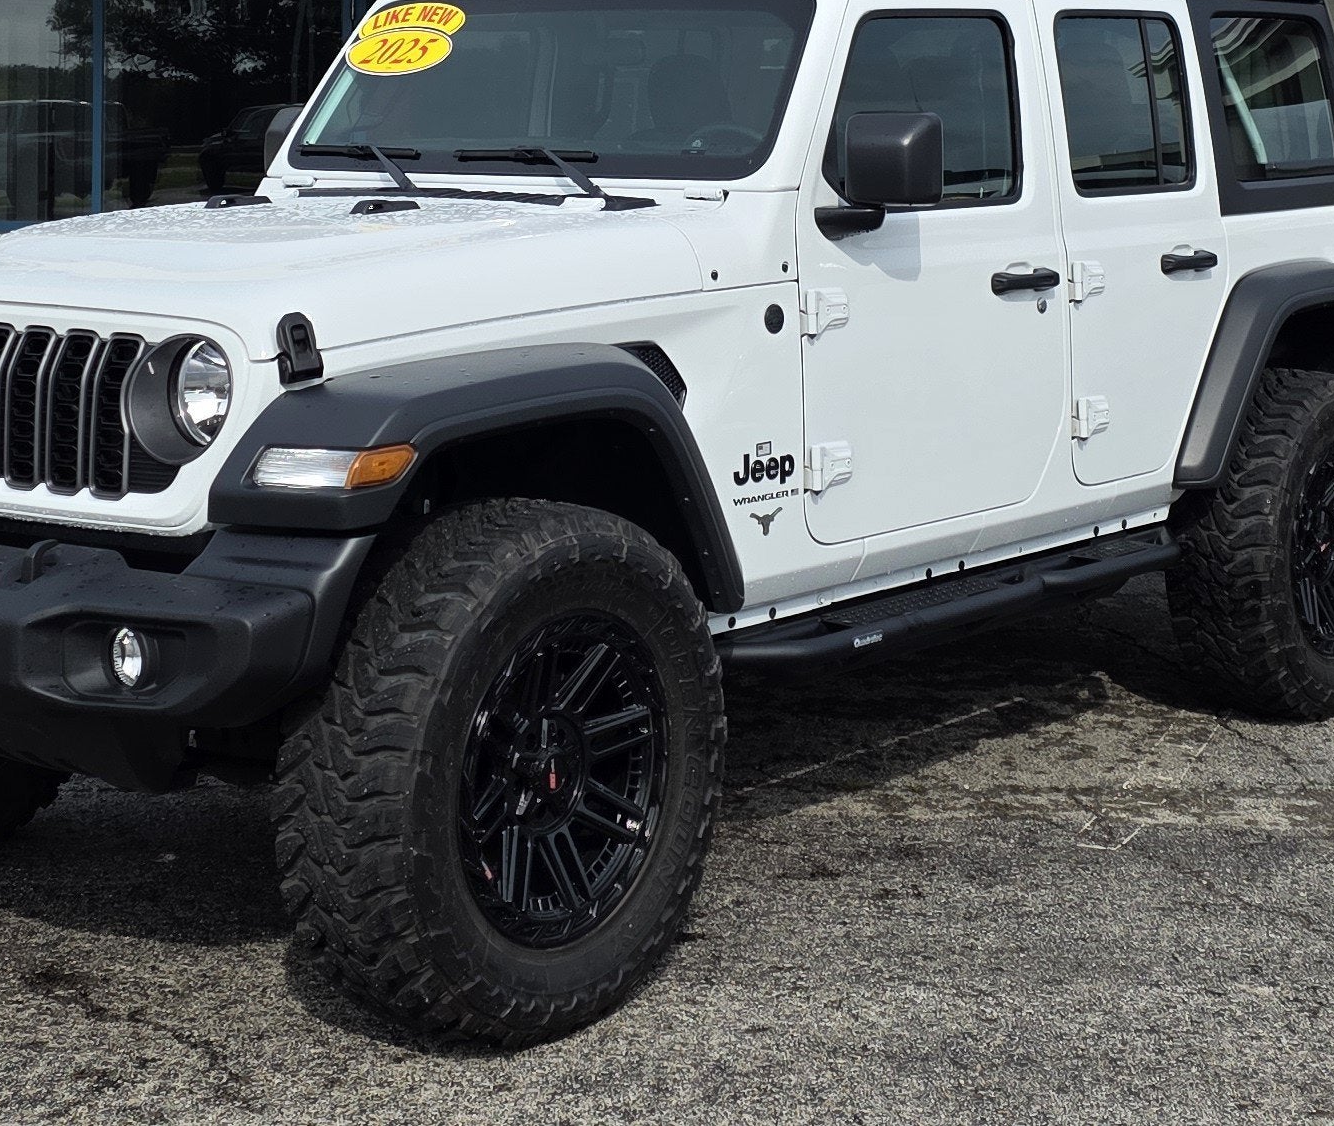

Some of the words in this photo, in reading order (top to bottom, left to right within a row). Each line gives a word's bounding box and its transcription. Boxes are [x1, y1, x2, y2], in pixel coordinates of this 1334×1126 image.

[372, 6, 417, 30] LIKE
[416, 5, 459, 27] NEW
[358, 37, 440, 65] 2025
[733, 453, 795, 486] Jeep
[733, 489, 789, 506] WRANGLER
